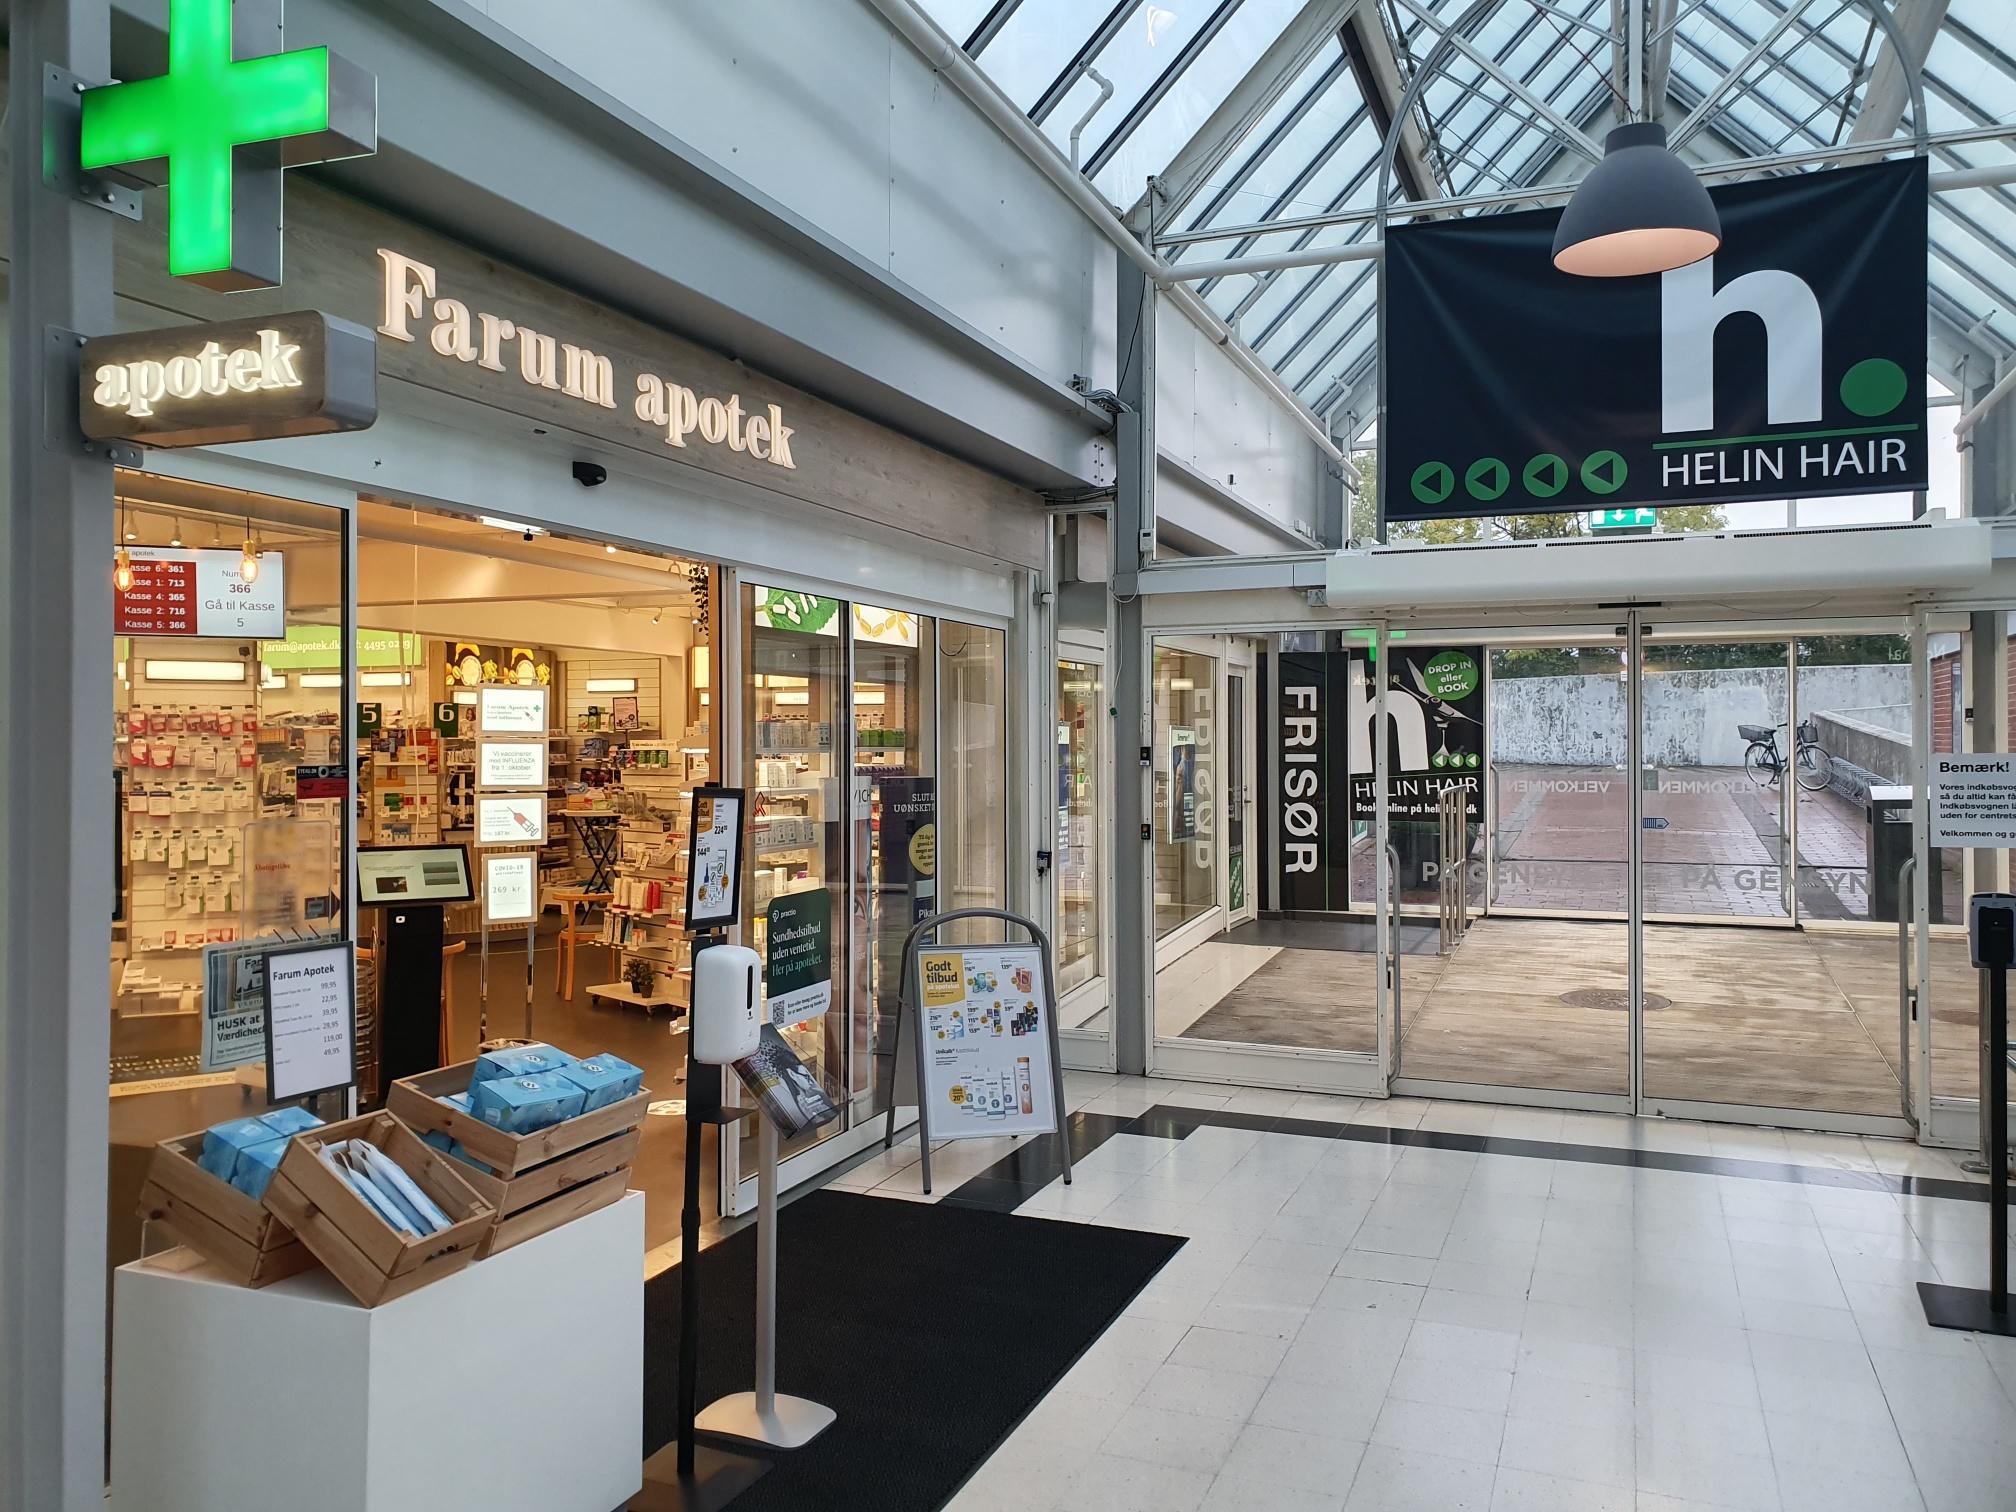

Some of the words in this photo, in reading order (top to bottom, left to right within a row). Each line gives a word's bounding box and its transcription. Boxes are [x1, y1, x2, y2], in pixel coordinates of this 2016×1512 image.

[377, 248, 617, 409] Farum
[635, 373, 797, 469] apotek
[93, 329, 302, 417] apotek
[1662, 447, 1784, 488] HELIN
[1801, 438, 1908, 479] HAIR
[229, 583, 251, 594] 366
[124, 592, 152, 600] Kasse
[124, 606, 152, 614] Kasse
[205, 599, 222, 610] Gå
[226, 599, 236, 611] til
[239, 601, 275, 612] Kasse
[125, 621, 153, 629] Kasse
[236, 617, 244, 628] 5
[1428, 662, 1457, 675] DROP
[1459, 660, 1472, 670] IN
[1440, 673, 1463, 683] eller
[1437, 682, 1470, 694] BOOK
[362, 703, 377, 723] 5
[438, 703, 455, 722] 6
[1940, 761, 2010, 773] Bemærk!
[1284, 686, 1318, 873] FRISØR
[1939, 783, 1965, 791] Vores
[1411, 803, 1422, 815] på
[1940, 802, 2009, 810] Indkøbsvognen
[1940, 829, 1993, 837] Velkommen
[1995, 831, 2007, 839] og
[772, 920, 821, 944] Sundhedstilbud
[772, 946, 789, 961] uden
[789, 937, 817, 956] ventetid.
[273, 969, 301, 981] Farum
[303, 964, 335, 978] Apotek
[772, 963, 785, 977] Her
[786, 959, 794, 976] på
[926, 960, 952, 972] Godt
[926, 971, 958, 984] tilbud
[217, 1016, 246, 1031] HUSK
[249, 1015, 261, 1024] at
